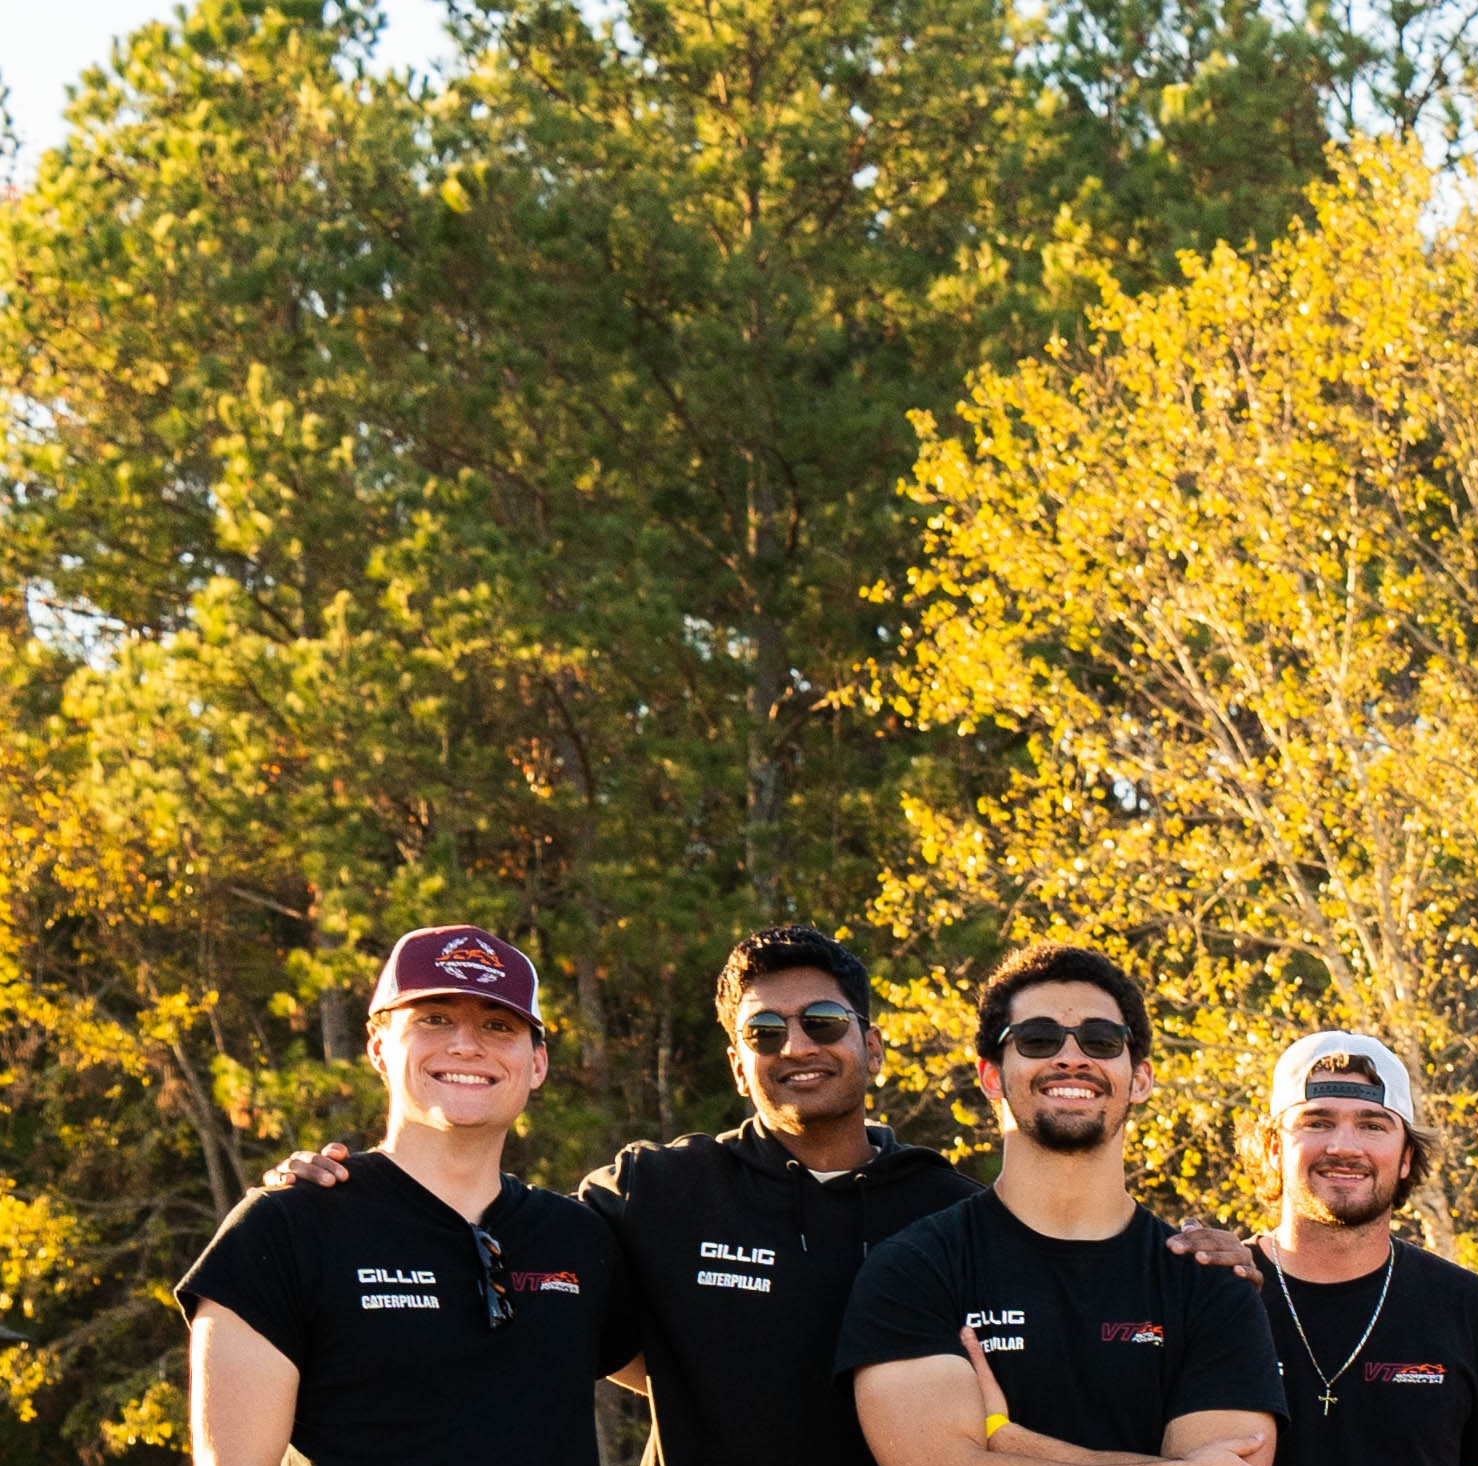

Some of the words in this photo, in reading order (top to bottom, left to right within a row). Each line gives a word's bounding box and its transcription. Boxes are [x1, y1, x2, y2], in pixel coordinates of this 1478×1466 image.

[700, 1241, 777, 1266] GILLIG
[357, 1268, 437, 1284] GILLIG
[697, 1271, 772, 1293] CATERPILLAR
[361, 1294, 440, 1310] CATERPILLAR
